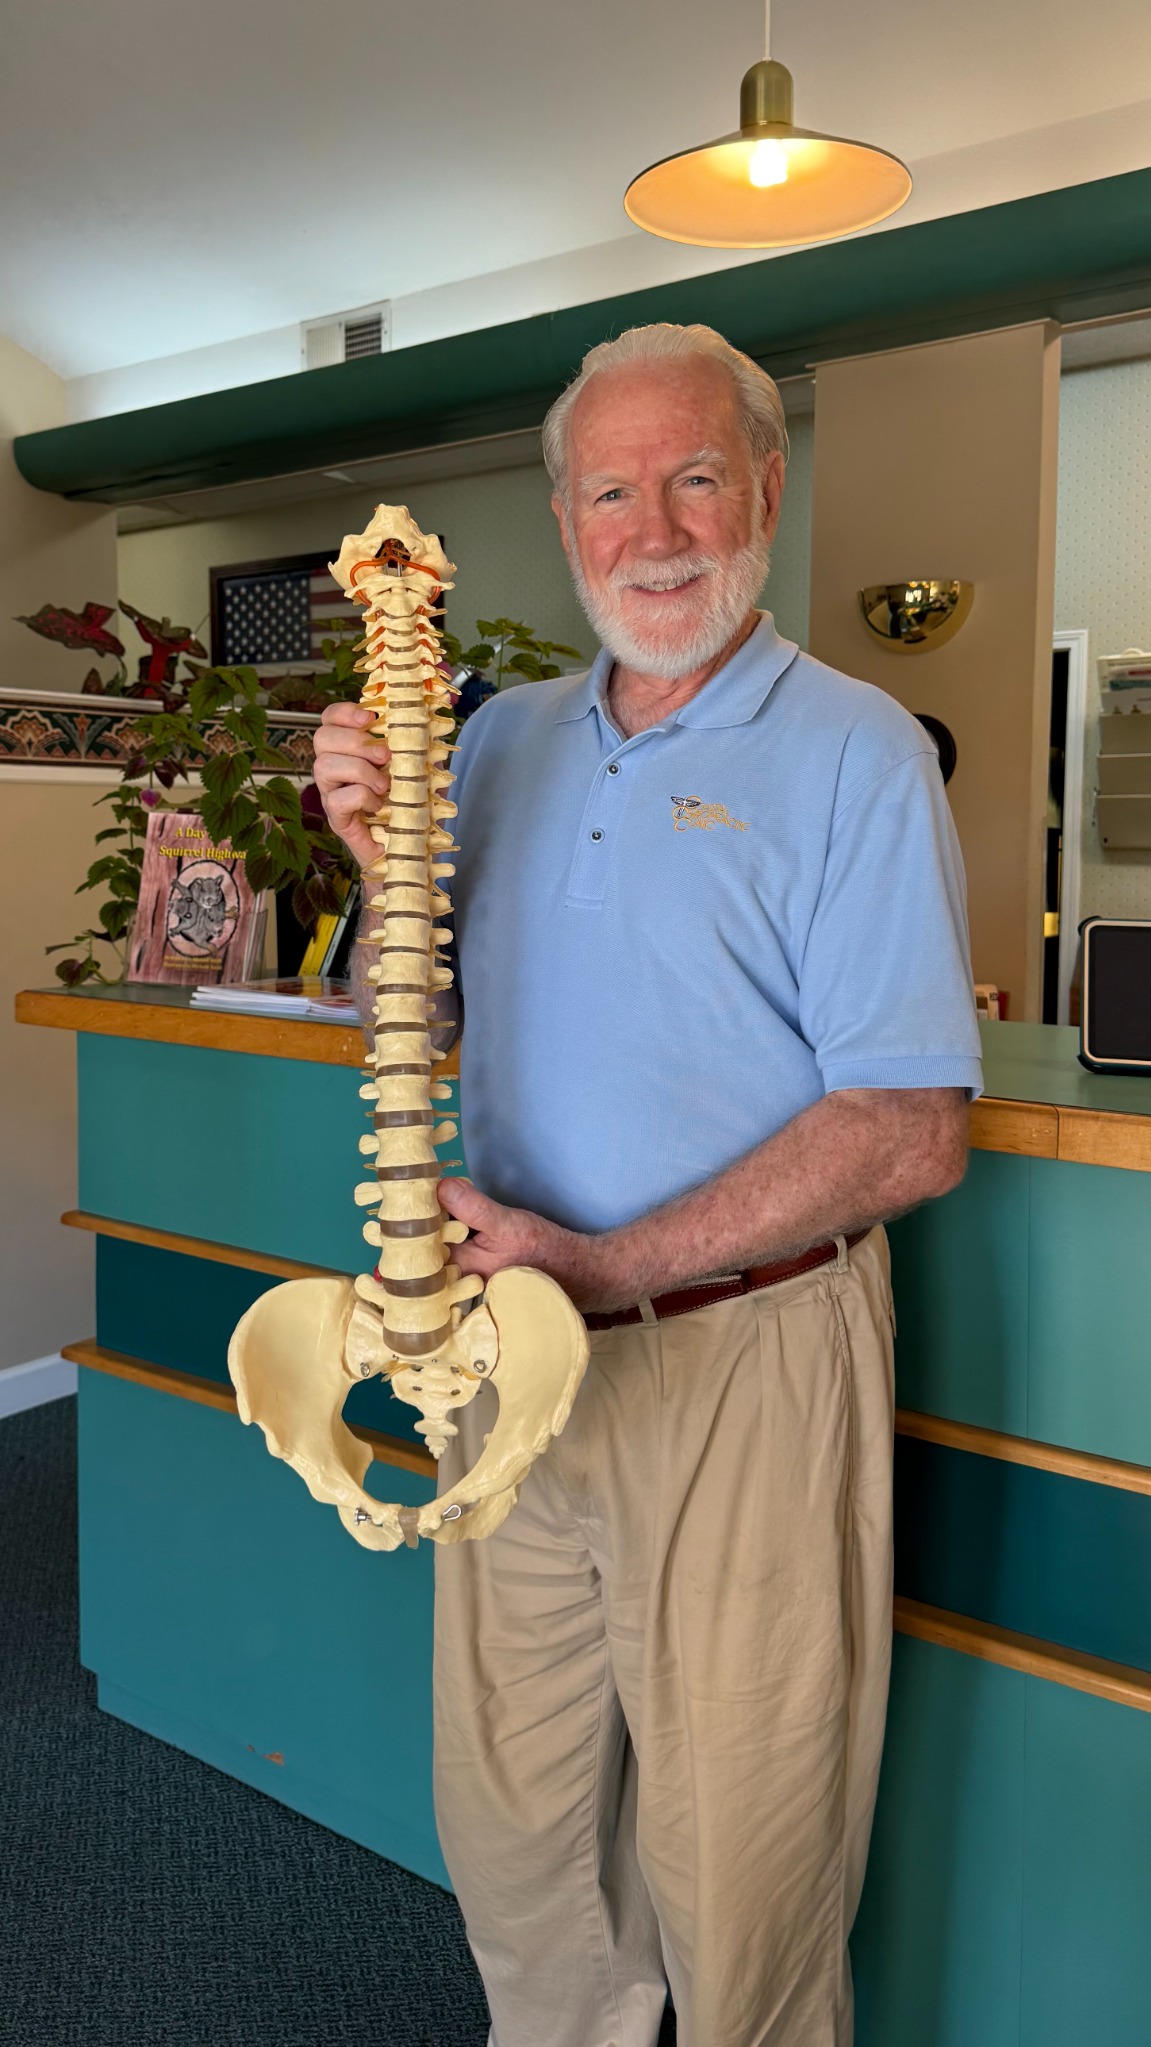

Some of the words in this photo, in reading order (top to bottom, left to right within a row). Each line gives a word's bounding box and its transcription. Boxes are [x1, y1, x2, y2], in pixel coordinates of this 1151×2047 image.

[175, 827, 183, 838] A
[185, 827, 207, 839] Day
[159, 845, 204, 859] Squirrel
[206, 847, 247, 861] Highwa
